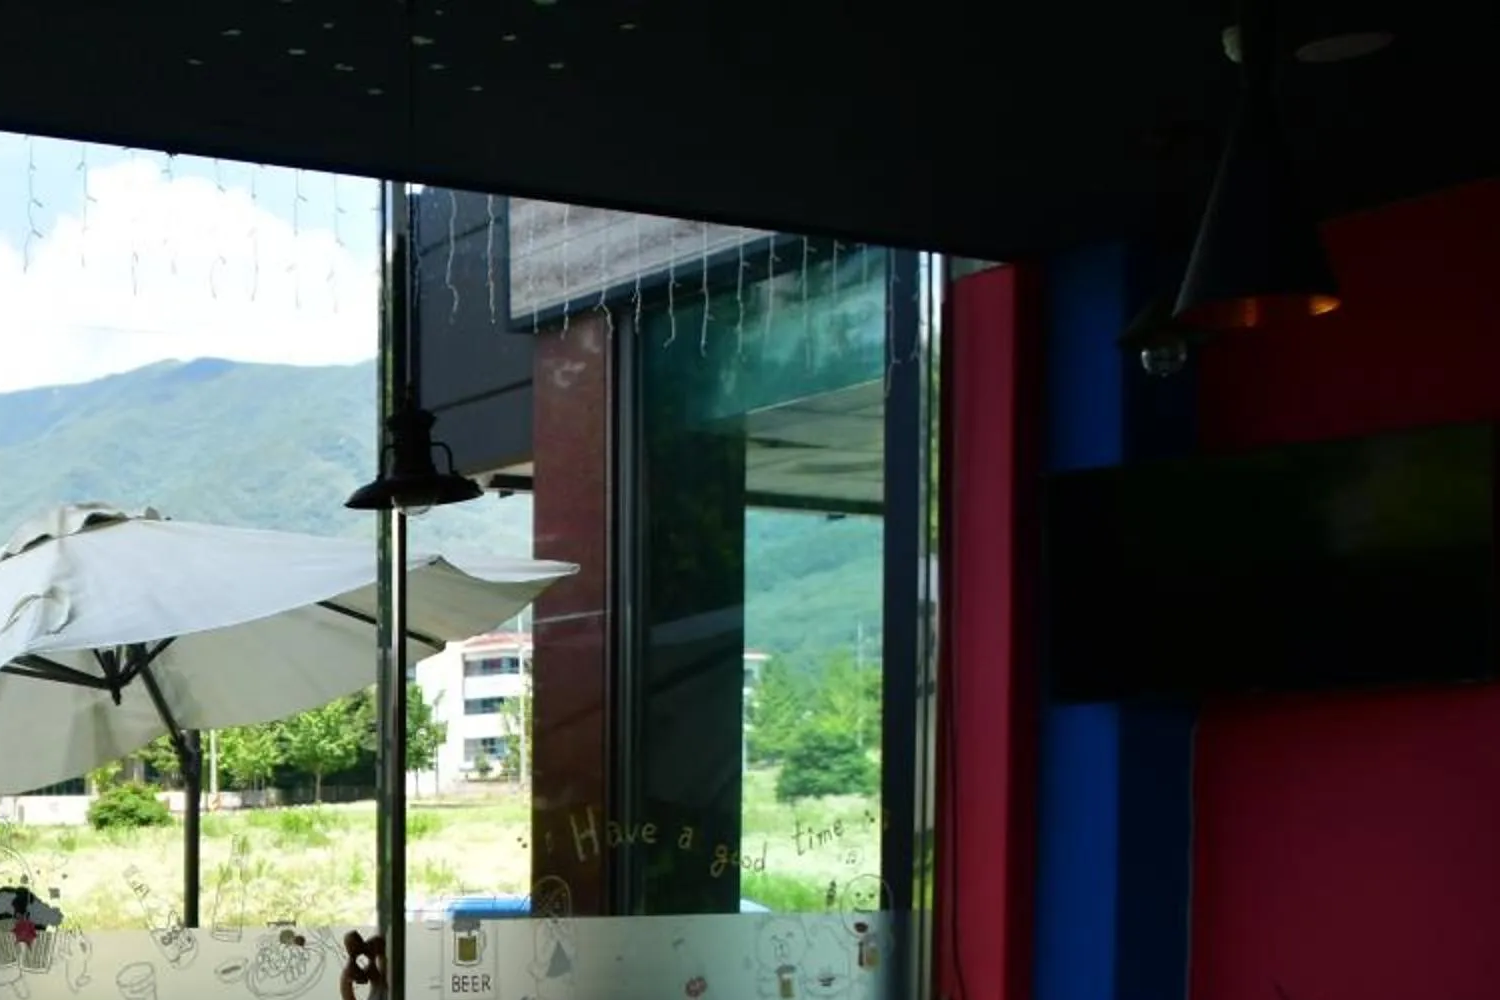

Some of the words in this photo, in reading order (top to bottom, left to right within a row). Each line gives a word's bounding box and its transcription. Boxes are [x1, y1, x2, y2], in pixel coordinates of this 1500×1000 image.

[569, 805, 658, 862] Have
[790, 816, 846, 857] time
[451, 974, 492, 993] BEER
